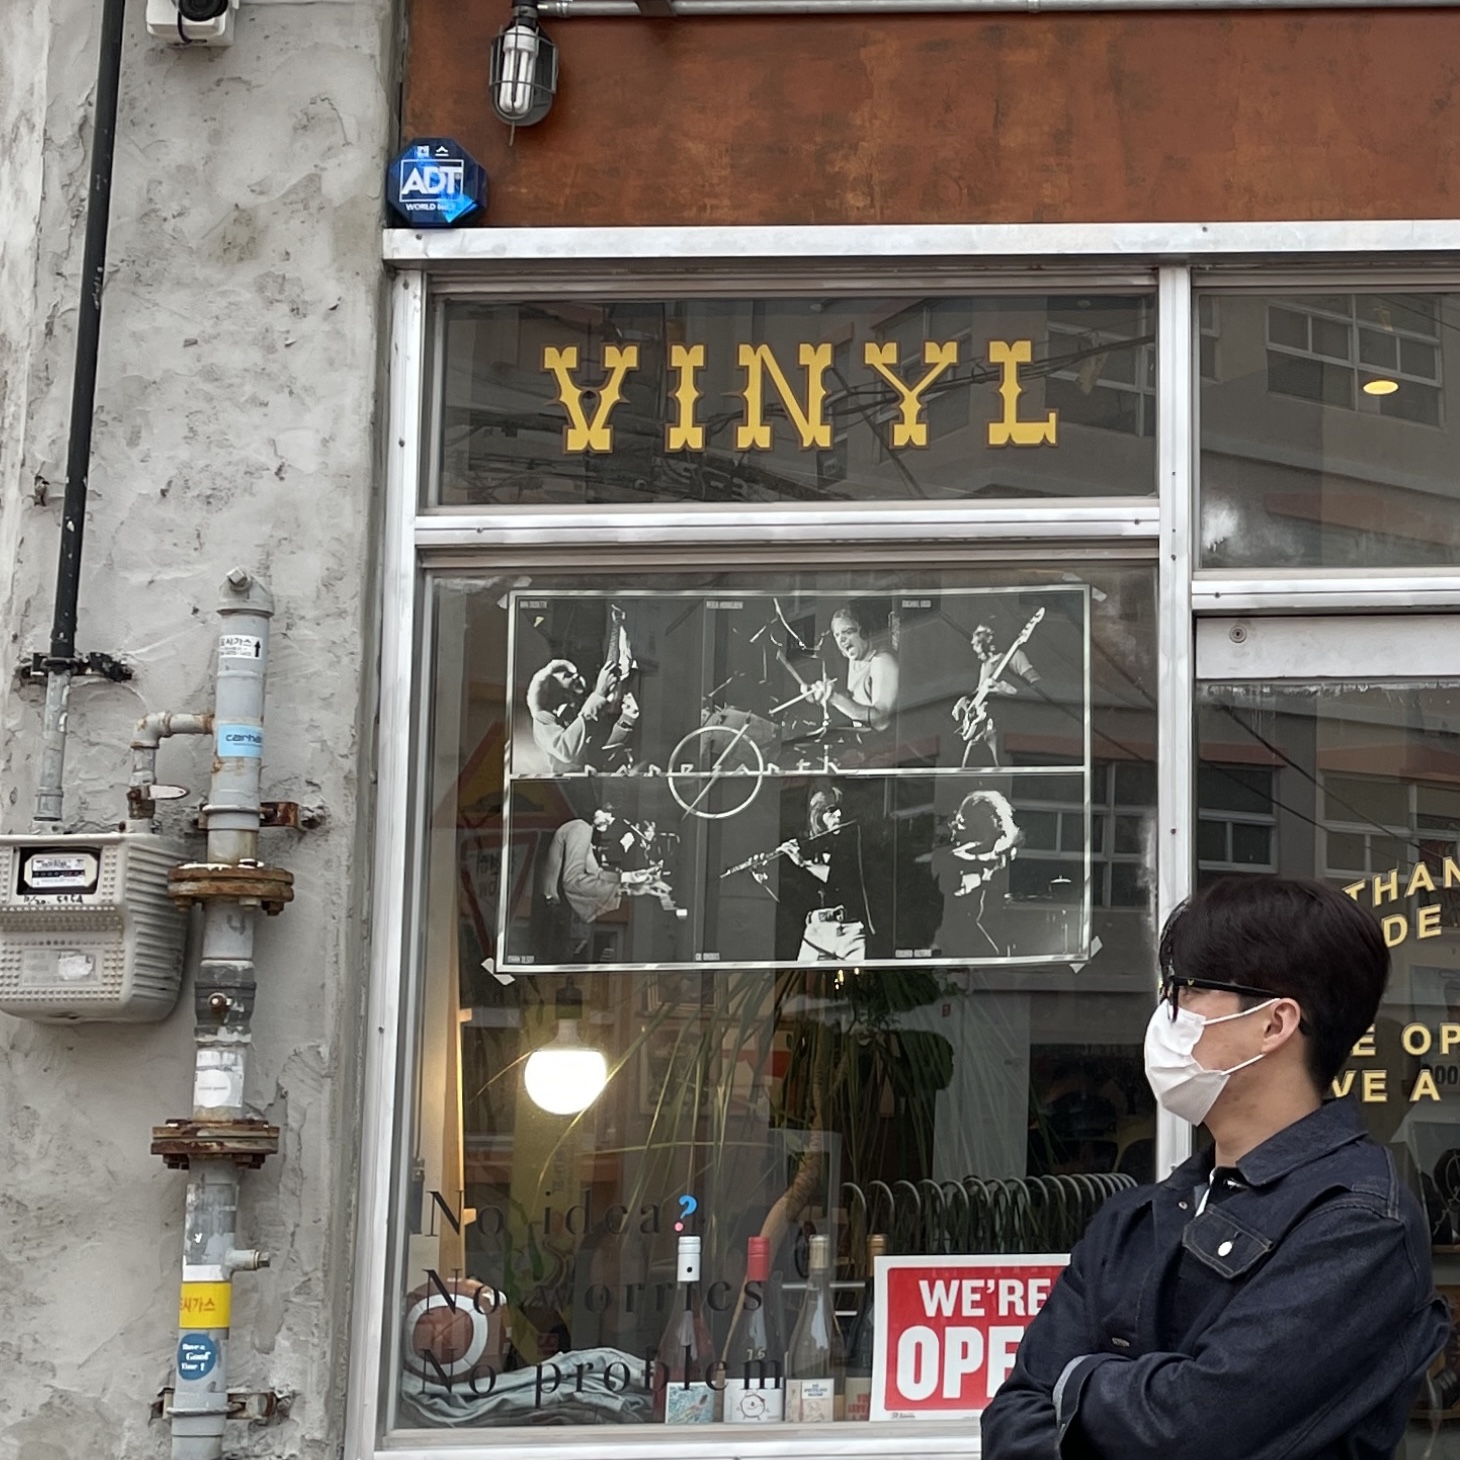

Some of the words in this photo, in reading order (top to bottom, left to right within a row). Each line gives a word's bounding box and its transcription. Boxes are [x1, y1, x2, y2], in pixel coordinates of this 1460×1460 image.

[401, 166, 462, 195] ADT
[543, 341, 1057, 454] VINYL
[1381, 904, 1442, 948] DE
[1352, 1023, 1376, 1056] E
[1331, 1070, 1387, 1102] VE
[1409, 1069, 1440, 1101] A
[426, 1190, 503, 1236] No
[423, 1268, 501, 1316] No
[534, 1266, 763, 1315] worries
[918, 1278, 1051, 1317] WE'RE
[423, 1349, 496, 1395] No
[534, 1345, 783, 1409] problem
[896, 1325, 1026, 1401] OPE
